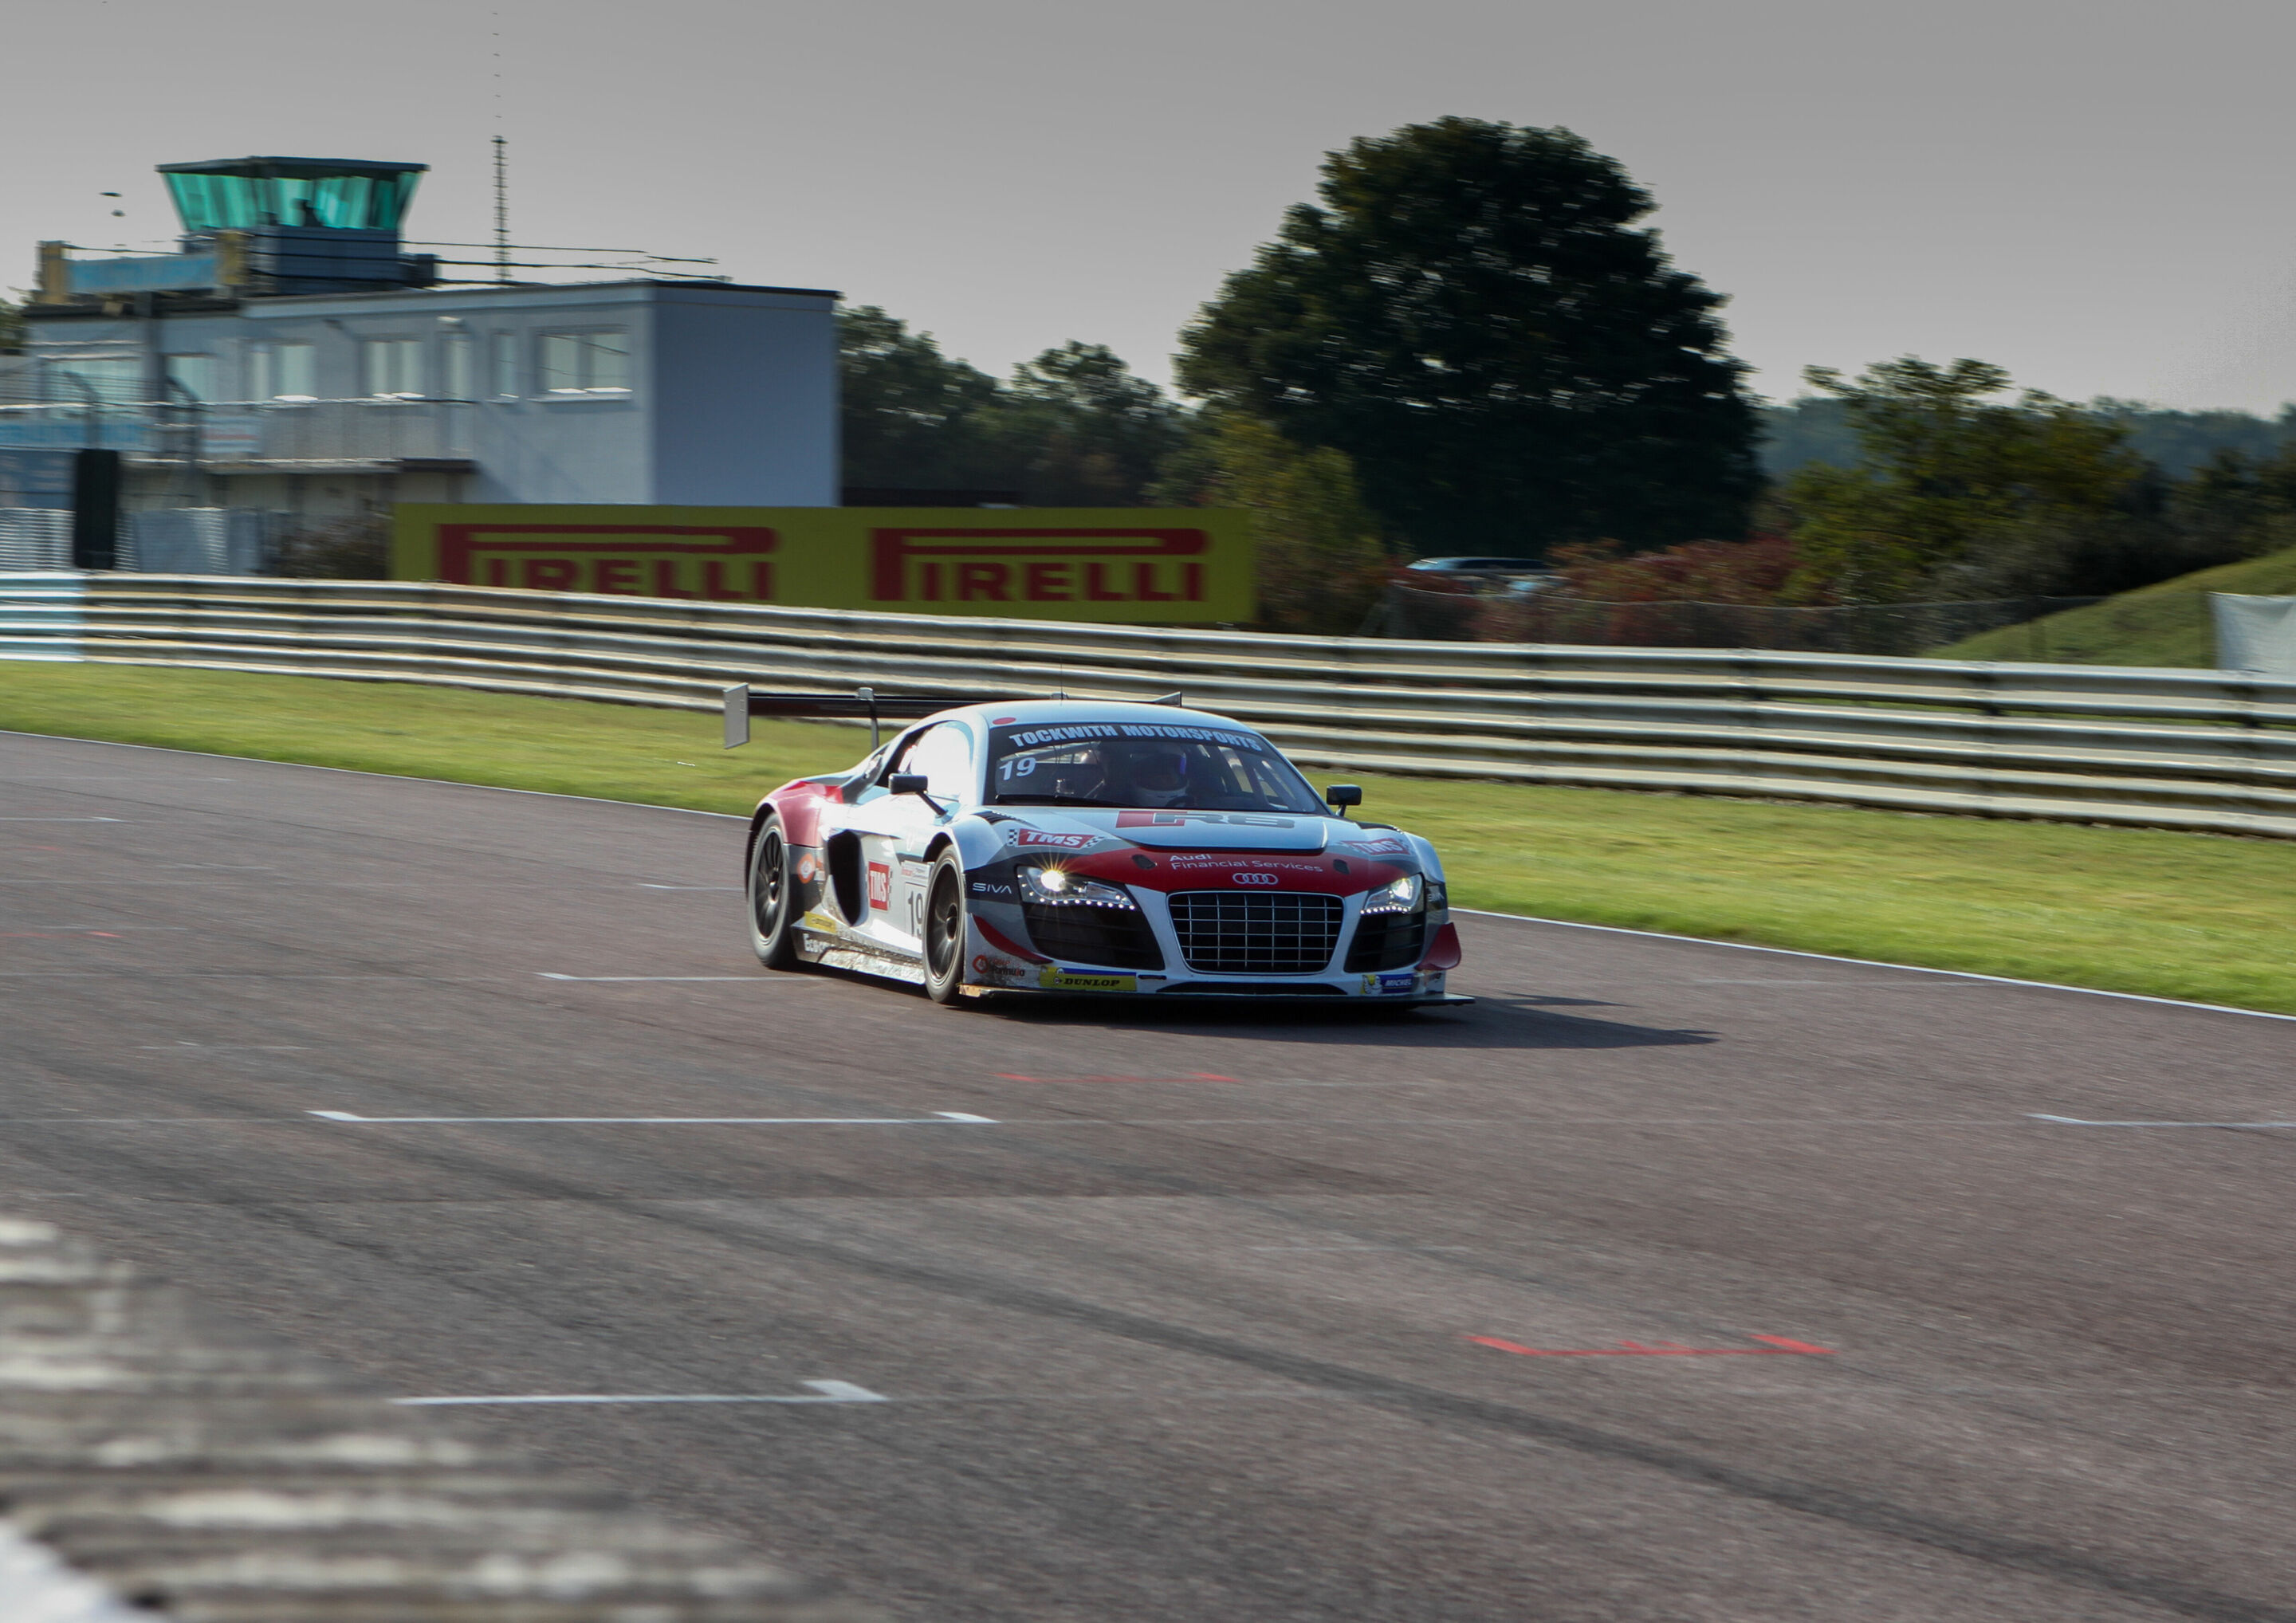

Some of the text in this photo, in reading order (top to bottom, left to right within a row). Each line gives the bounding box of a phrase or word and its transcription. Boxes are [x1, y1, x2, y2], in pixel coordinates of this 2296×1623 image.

[438, 524, 778, 601] PIRELLI
[869, 527, 1212, 602] PIRELLI
[1008, 725, 1263, 752] TOCKWITH MOTORSPORTS
[998, 757, 1036, 781] 19
[1026, 831, 1083, 847] TMS
[1352, 841, 1403, 854] TMS
[1170, 854, 1212, 863] Audi
[1171, 860, 1323, 873] Financial Services
[870, 870, 887, 902] TMS
[973, 882, 1012, 894] SIVA
[908, 890, 923, 940] 19
[1064, 977, 1120, 987] DUNLOP
